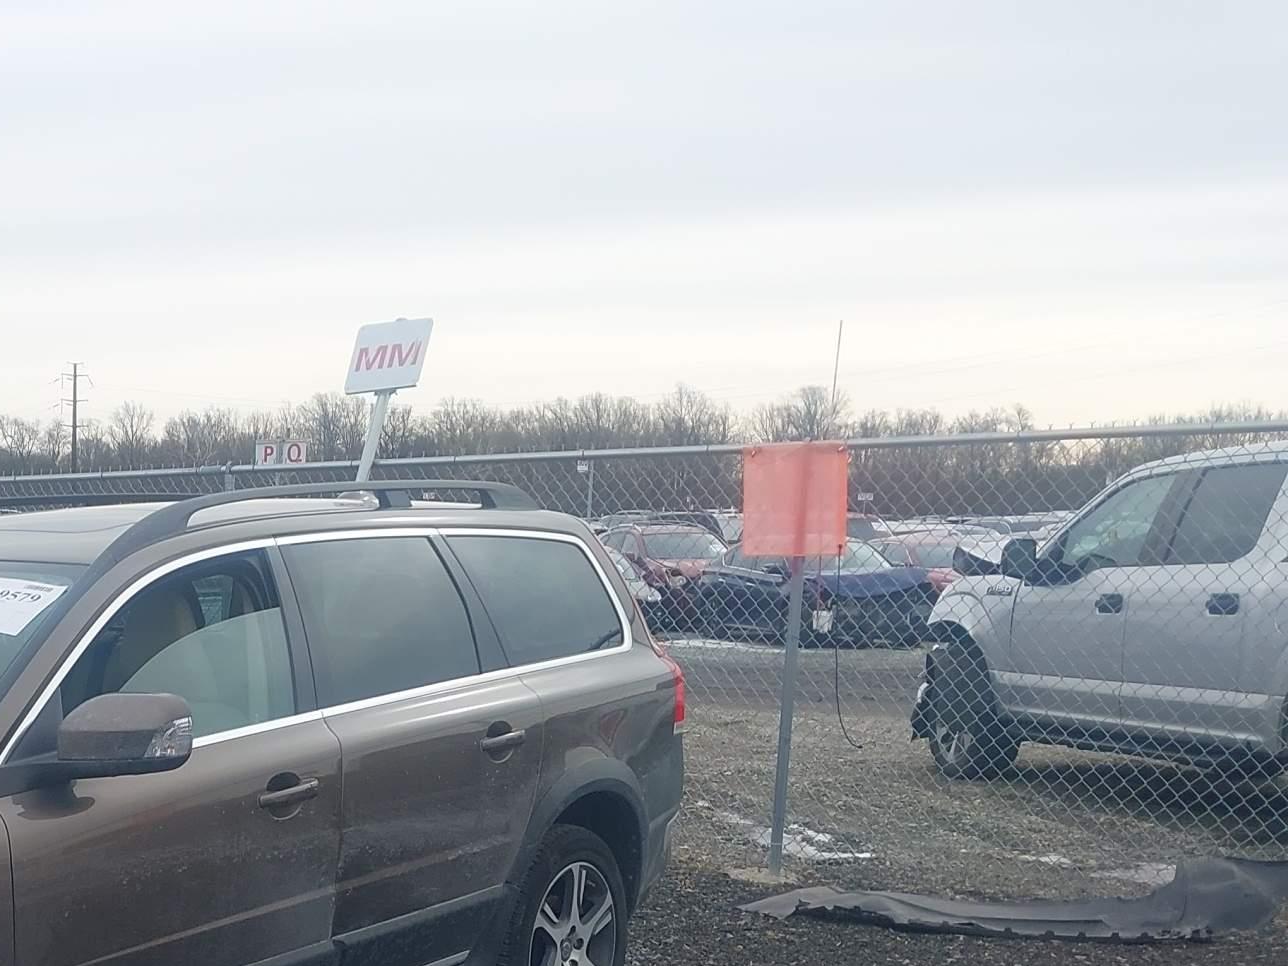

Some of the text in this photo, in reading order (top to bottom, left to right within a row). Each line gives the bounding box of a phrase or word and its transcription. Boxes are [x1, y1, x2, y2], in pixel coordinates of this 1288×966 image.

[354, 341, 422, 373] MM
[263, 445, 274, 463] P
[287, 443, 302, 463] Q
